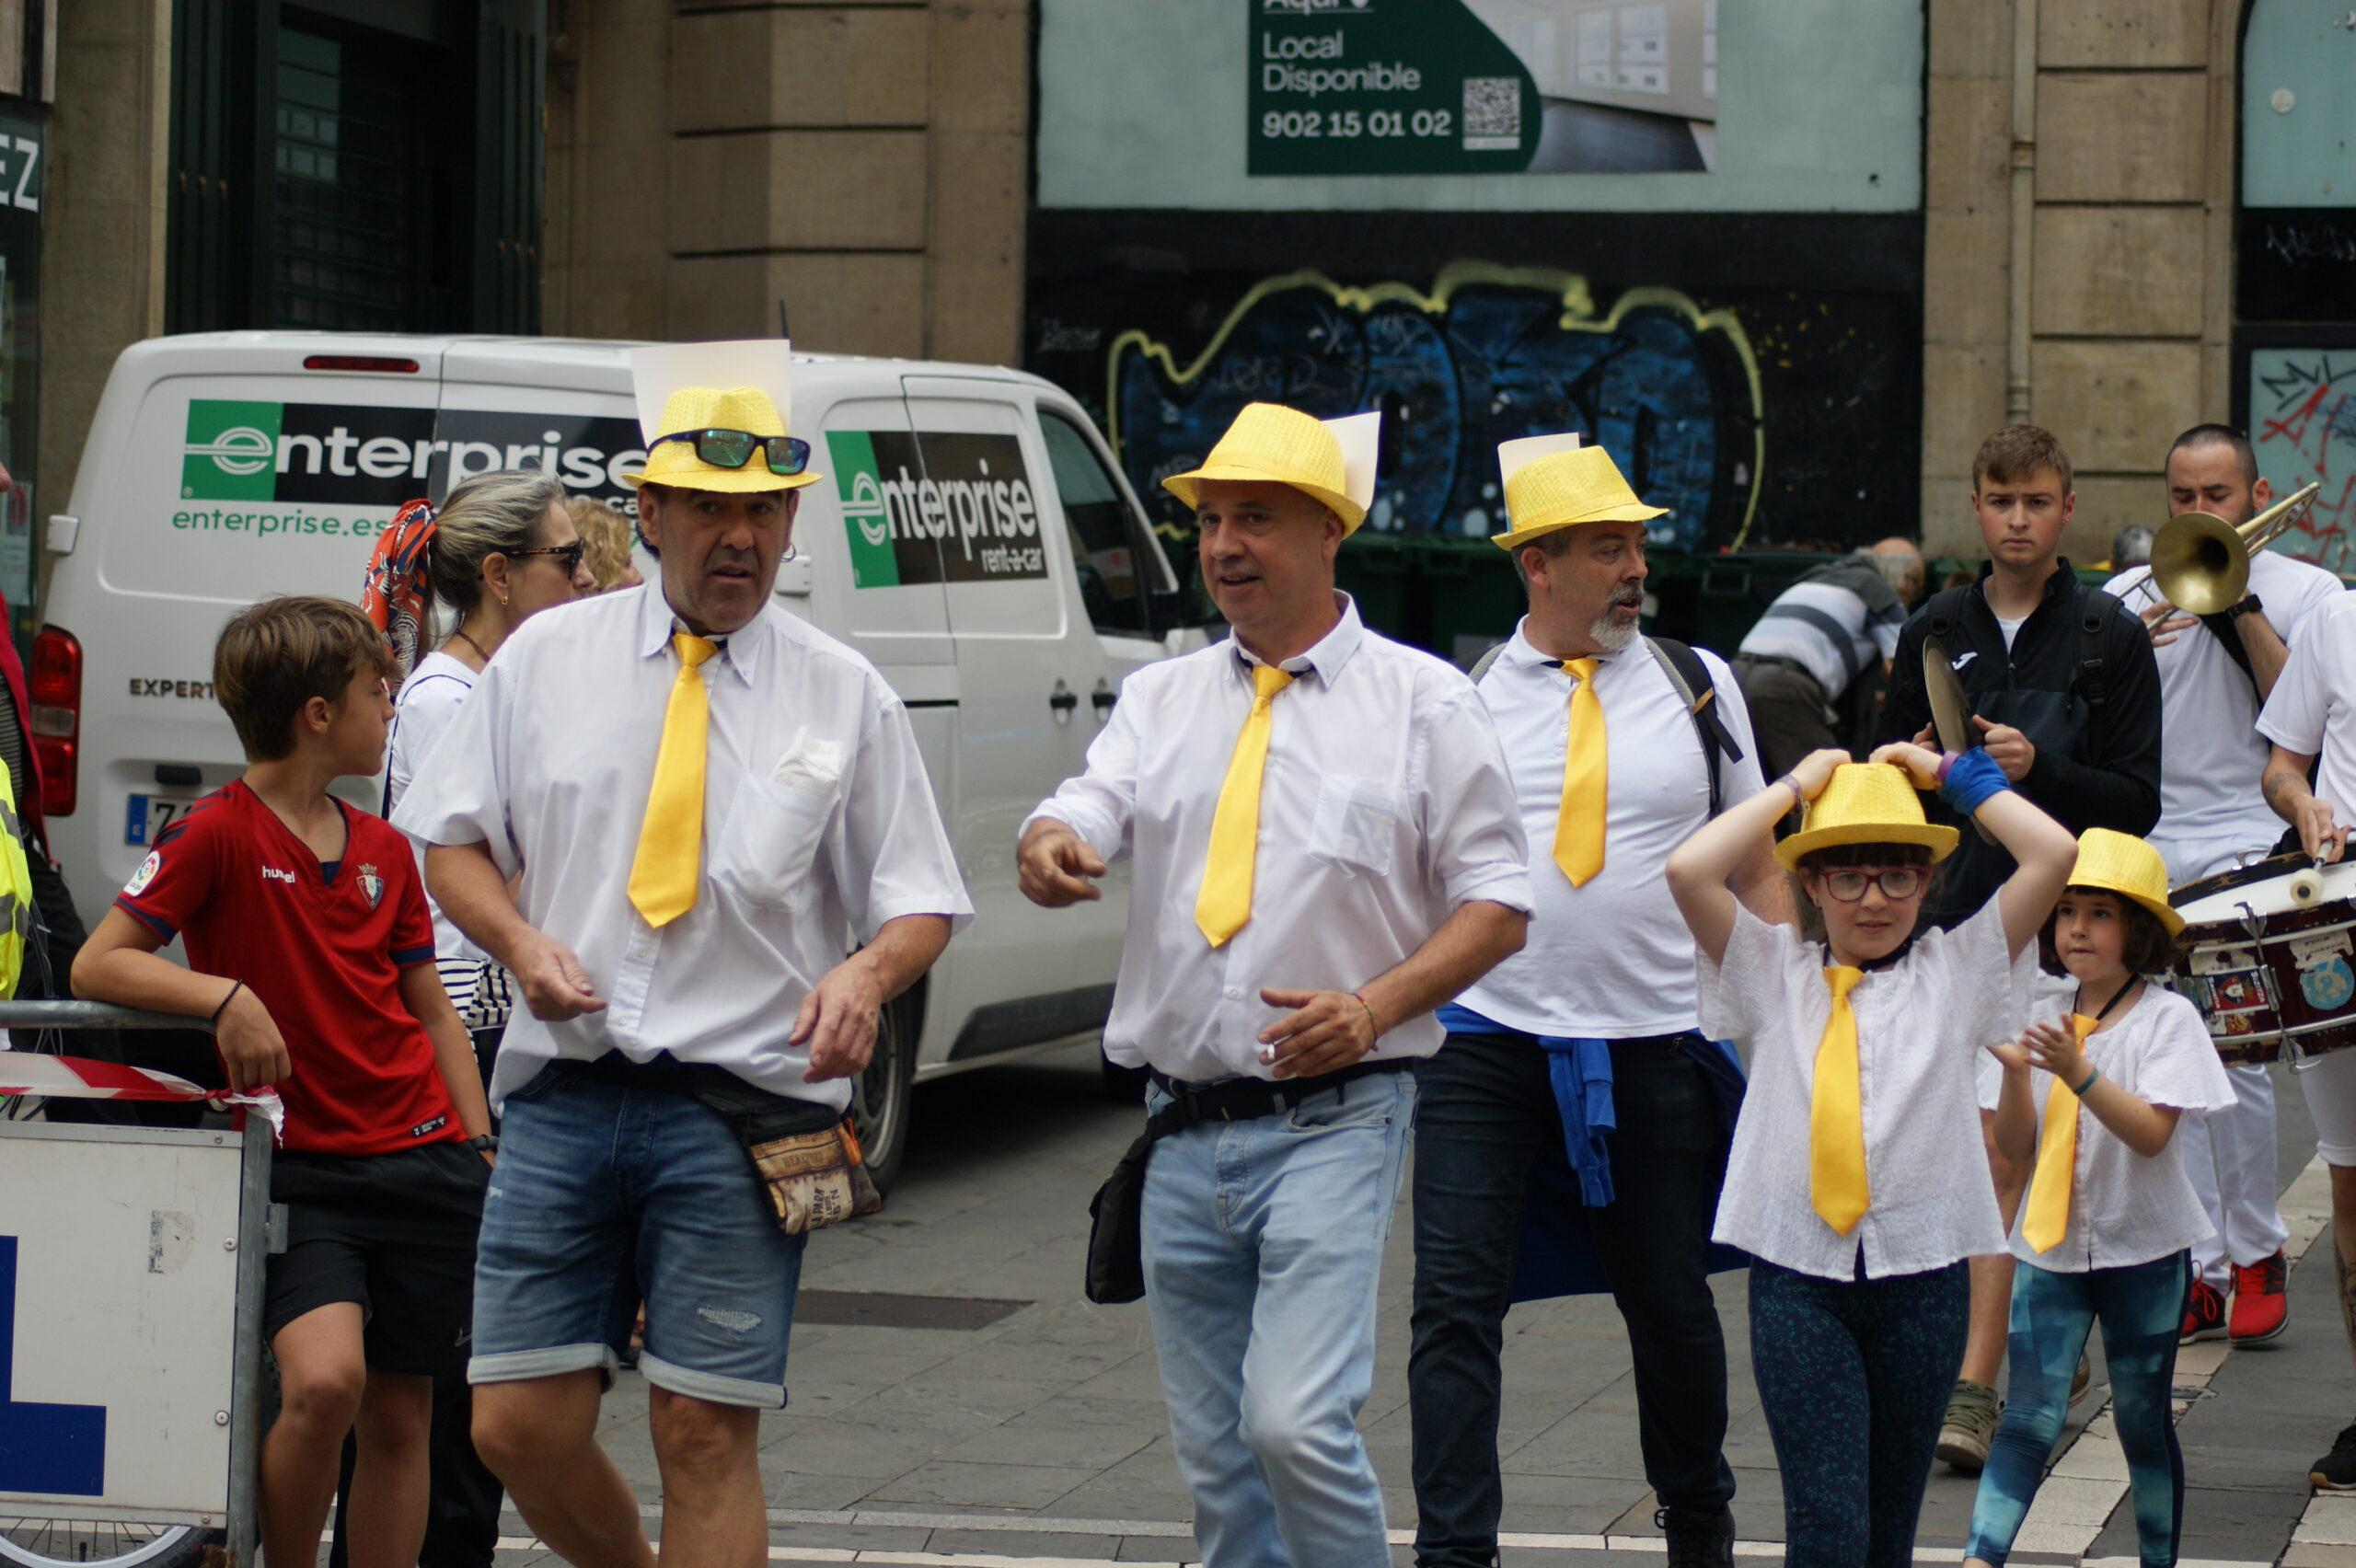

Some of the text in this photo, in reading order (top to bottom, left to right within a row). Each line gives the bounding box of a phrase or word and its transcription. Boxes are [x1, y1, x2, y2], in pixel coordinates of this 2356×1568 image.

[1263, 29, 1343, 59] Local
[1263, 61, 1421, 98] Disponible
[1262, 110, 1452, 138] 902 15 01 02
[172, 509, 388, 537] enterprise.es
[841, 457, 1036, 561] enterprise
[980, 544, 1044, 573] rent-a-car
[129, 677, 214, 699] EXPERT
